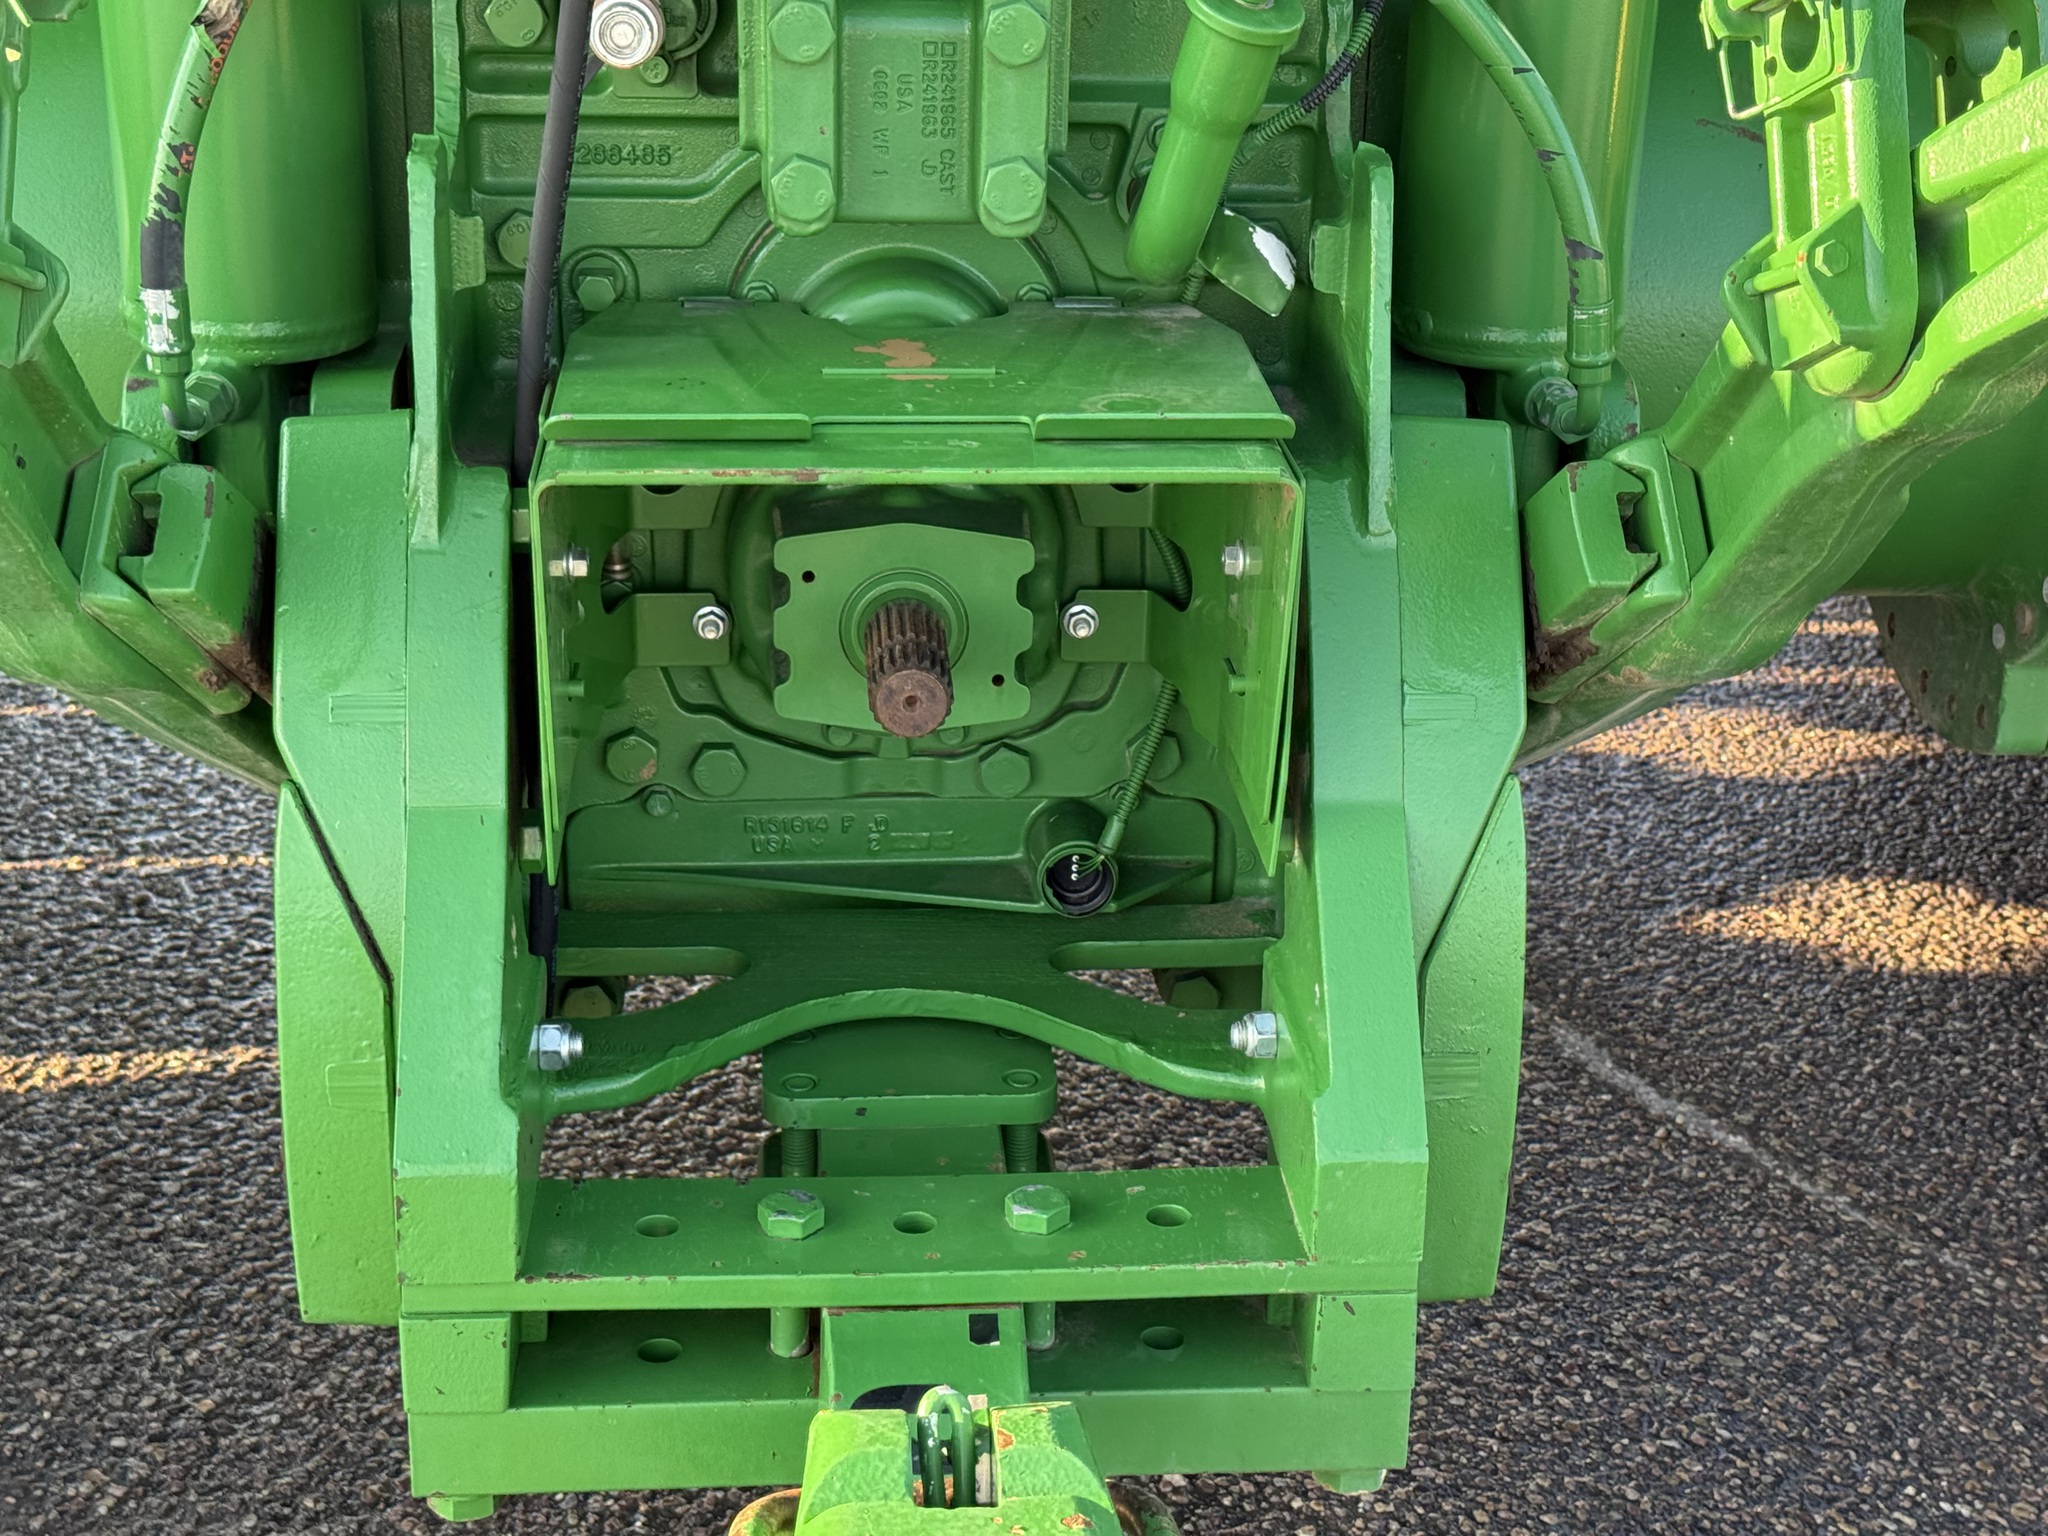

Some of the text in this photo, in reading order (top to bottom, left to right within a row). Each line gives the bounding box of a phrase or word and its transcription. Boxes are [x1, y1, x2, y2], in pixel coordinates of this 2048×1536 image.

[896, 73, 914, 112] USA
[921, 60, 939, 140] R241963
[939, 60, 957, 195] R241965 CAST
[841, 813, 855, 834] F
[752, 834, 794, 854] USA
